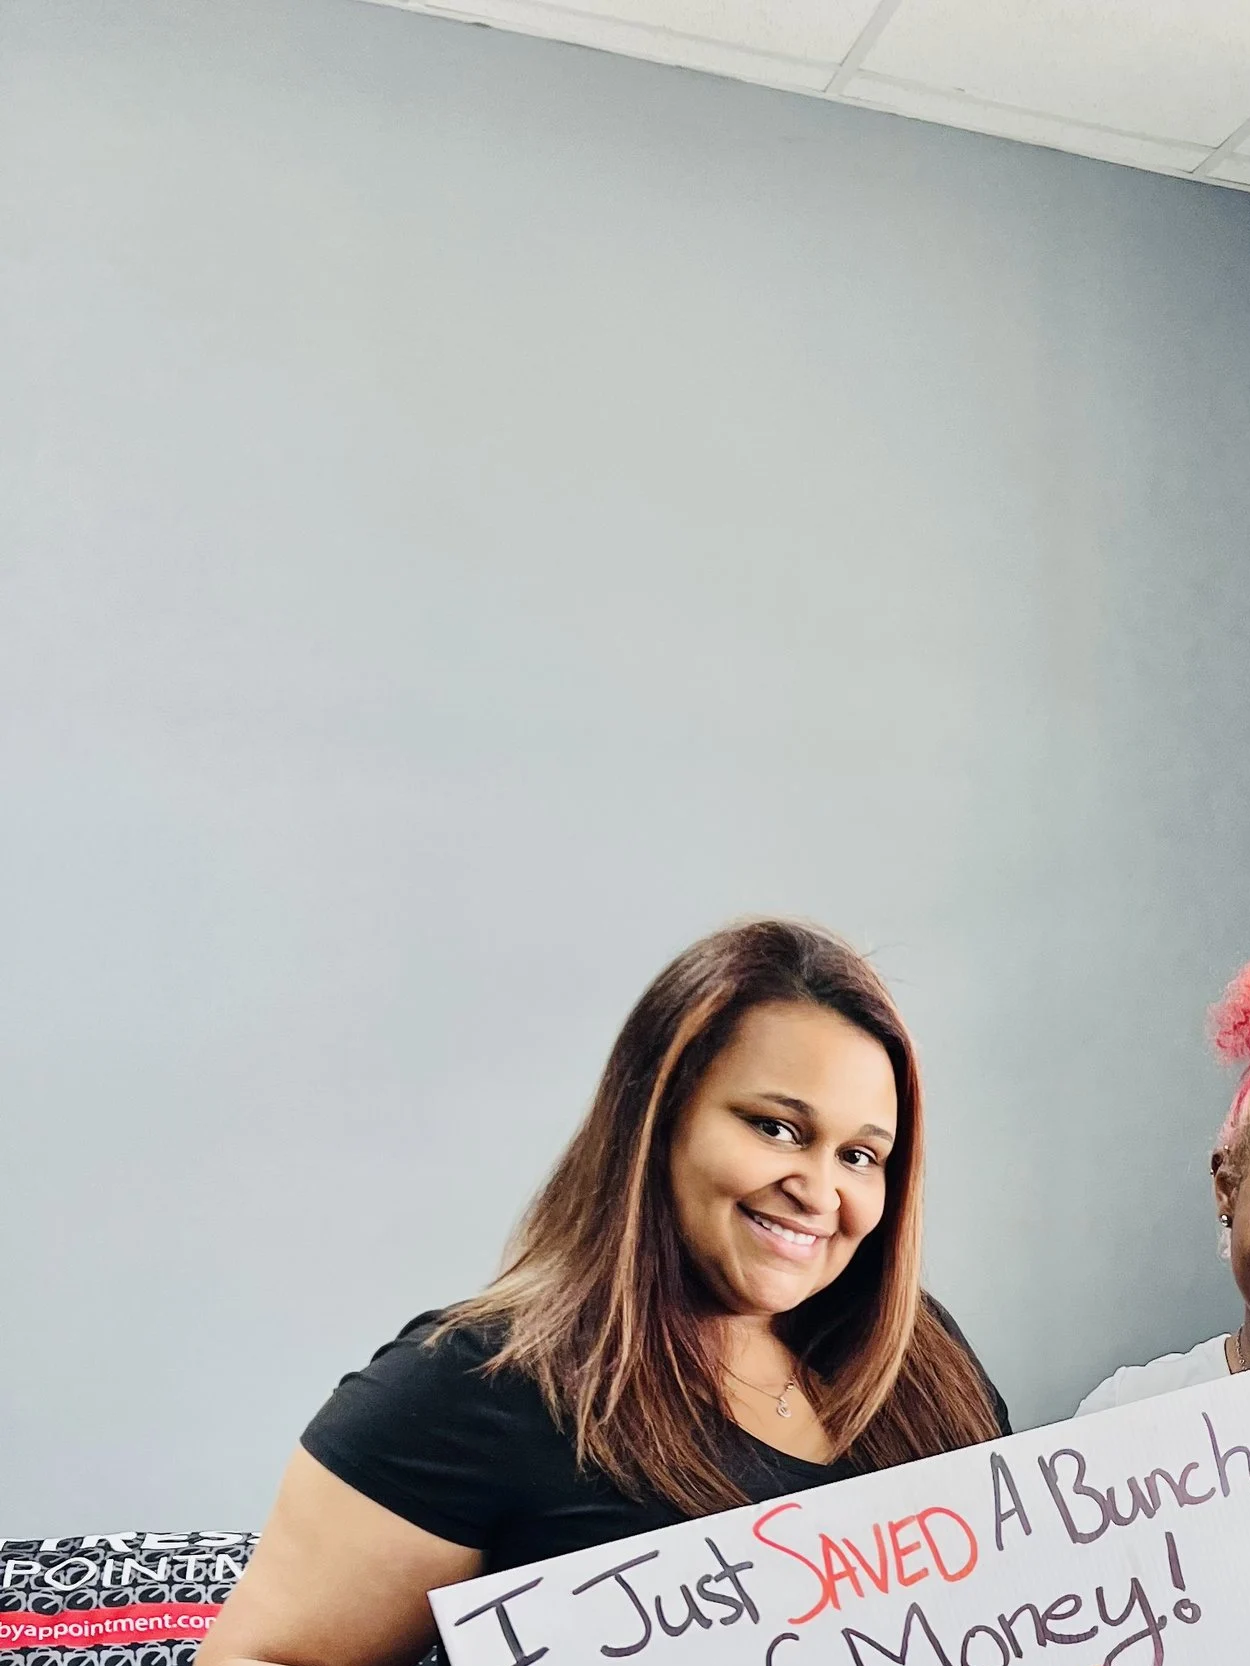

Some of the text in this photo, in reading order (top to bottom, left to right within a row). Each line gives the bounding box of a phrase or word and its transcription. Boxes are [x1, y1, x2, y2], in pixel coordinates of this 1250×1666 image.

[571, 1536, 754, 1658] Just
[752, 1502, 979, 1625] SAVED
[990, 1450, 1033, 1551] A
